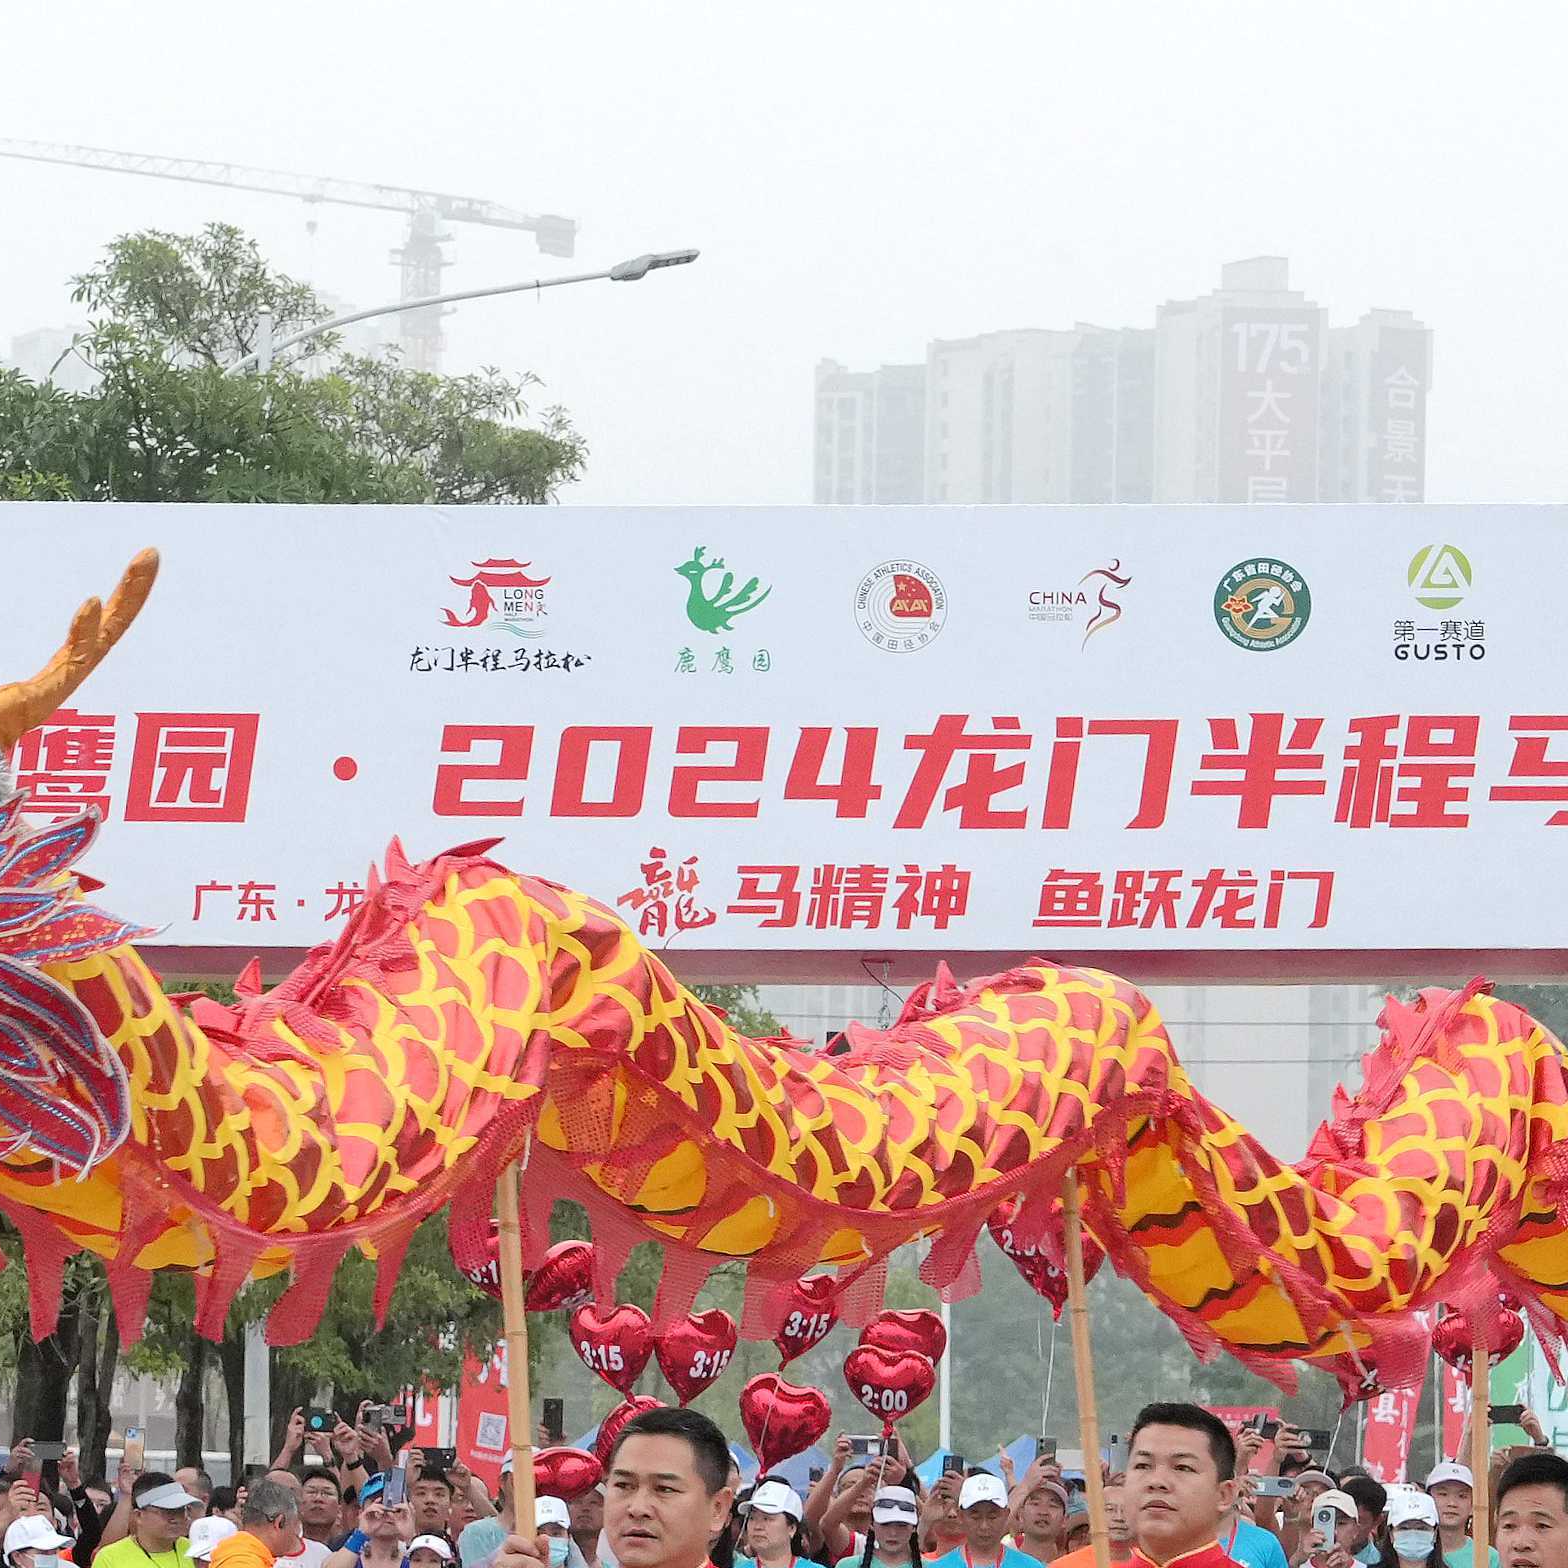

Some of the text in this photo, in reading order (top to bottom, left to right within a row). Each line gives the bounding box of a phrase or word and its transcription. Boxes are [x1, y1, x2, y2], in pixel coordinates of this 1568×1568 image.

[1231, 321, 1311, 375] 175
[504, 588, 544, 600] LONG
[504, 601, 534, 612] MEN
[1029, 591, 1087, 605] CHINA
[1393, 619, 1486, 642] 第一赛道
[409, 646, 592, 673] 龙门半程马拉松
[673, 646, 773, 674] 鹿鹰园
[1394, 643, 1486, 661] GUSTO
[1032, 867, 1335, 930] 鱼跃龙门
[784, 1310, 831, 1341] 3:15
[580, 1340, 625, 1372] 3:15
[689, 1349, 732, 1380] 3:15
[861, 1384, 910, 1413] 2:00
